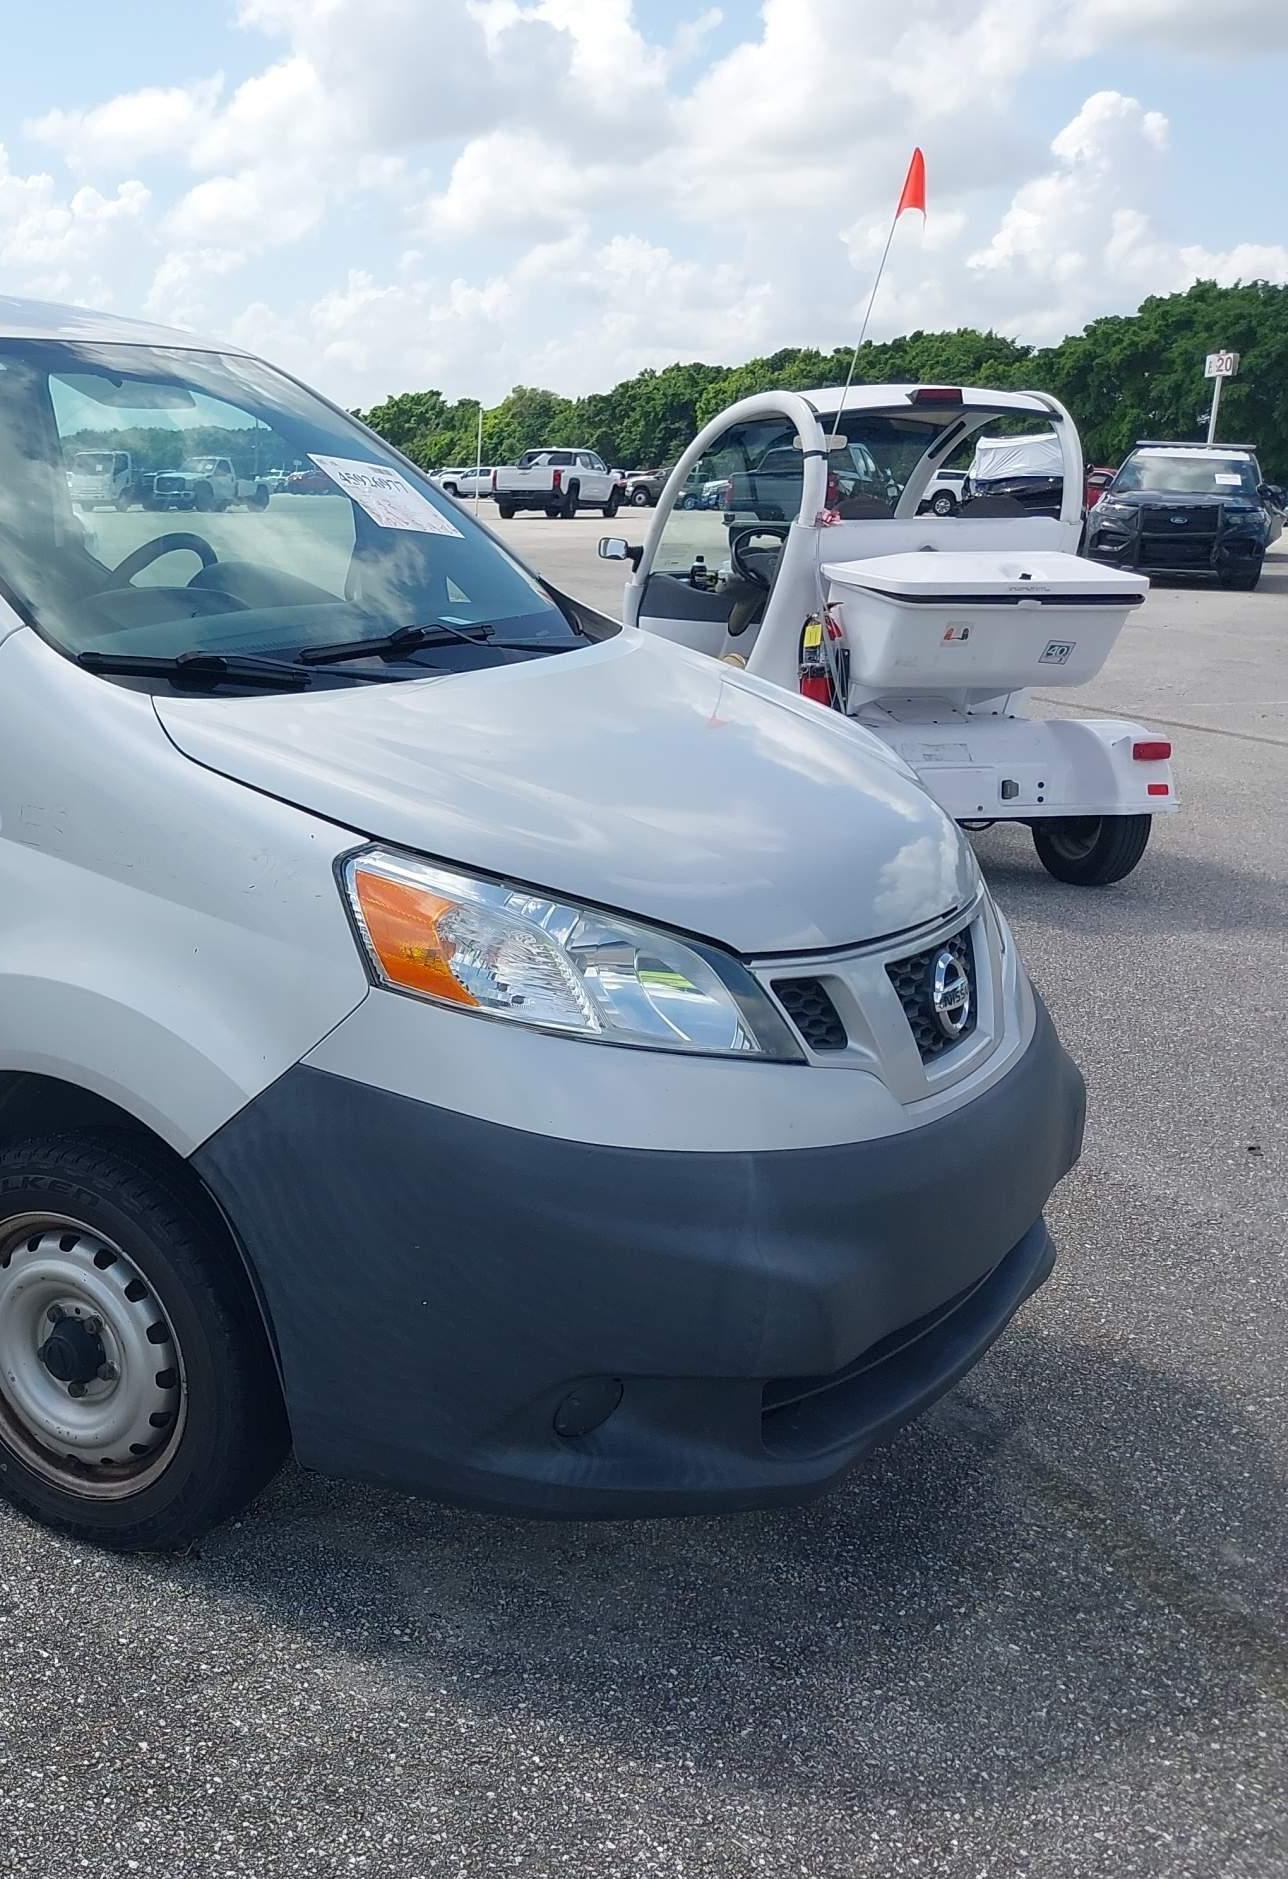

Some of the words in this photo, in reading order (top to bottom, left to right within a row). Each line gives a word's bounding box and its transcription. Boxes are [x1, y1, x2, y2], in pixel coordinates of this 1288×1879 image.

[1216, 356, 1232, 372] 20
[338, 471, 409, 494] 45926977
[942, 983, 968, 1008] NISS
